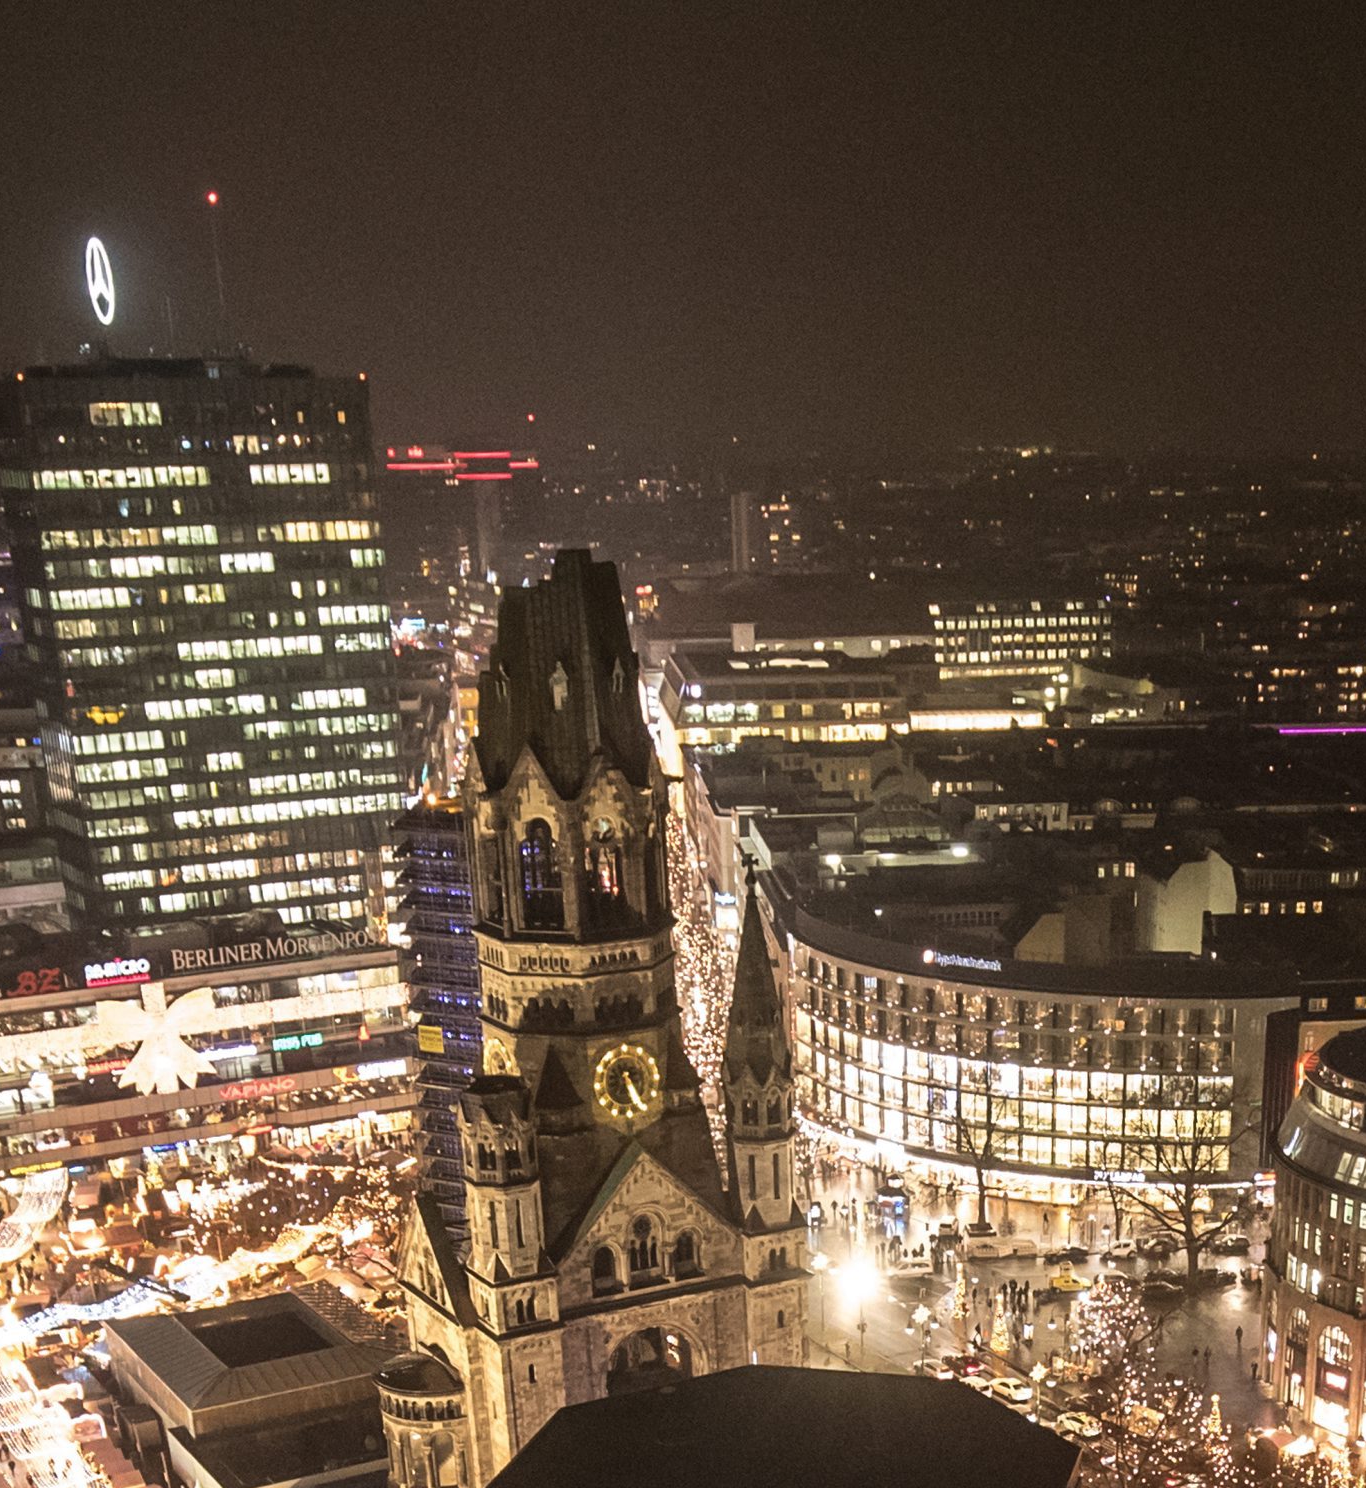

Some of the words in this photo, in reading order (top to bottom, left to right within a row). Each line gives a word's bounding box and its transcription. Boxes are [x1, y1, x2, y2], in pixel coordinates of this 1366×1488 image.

[171, 941, 263, 971] BERLINER
[266, 927, 387, 957] MORGENPOS
[219, 1077, 297, 1099] VAPIANO
